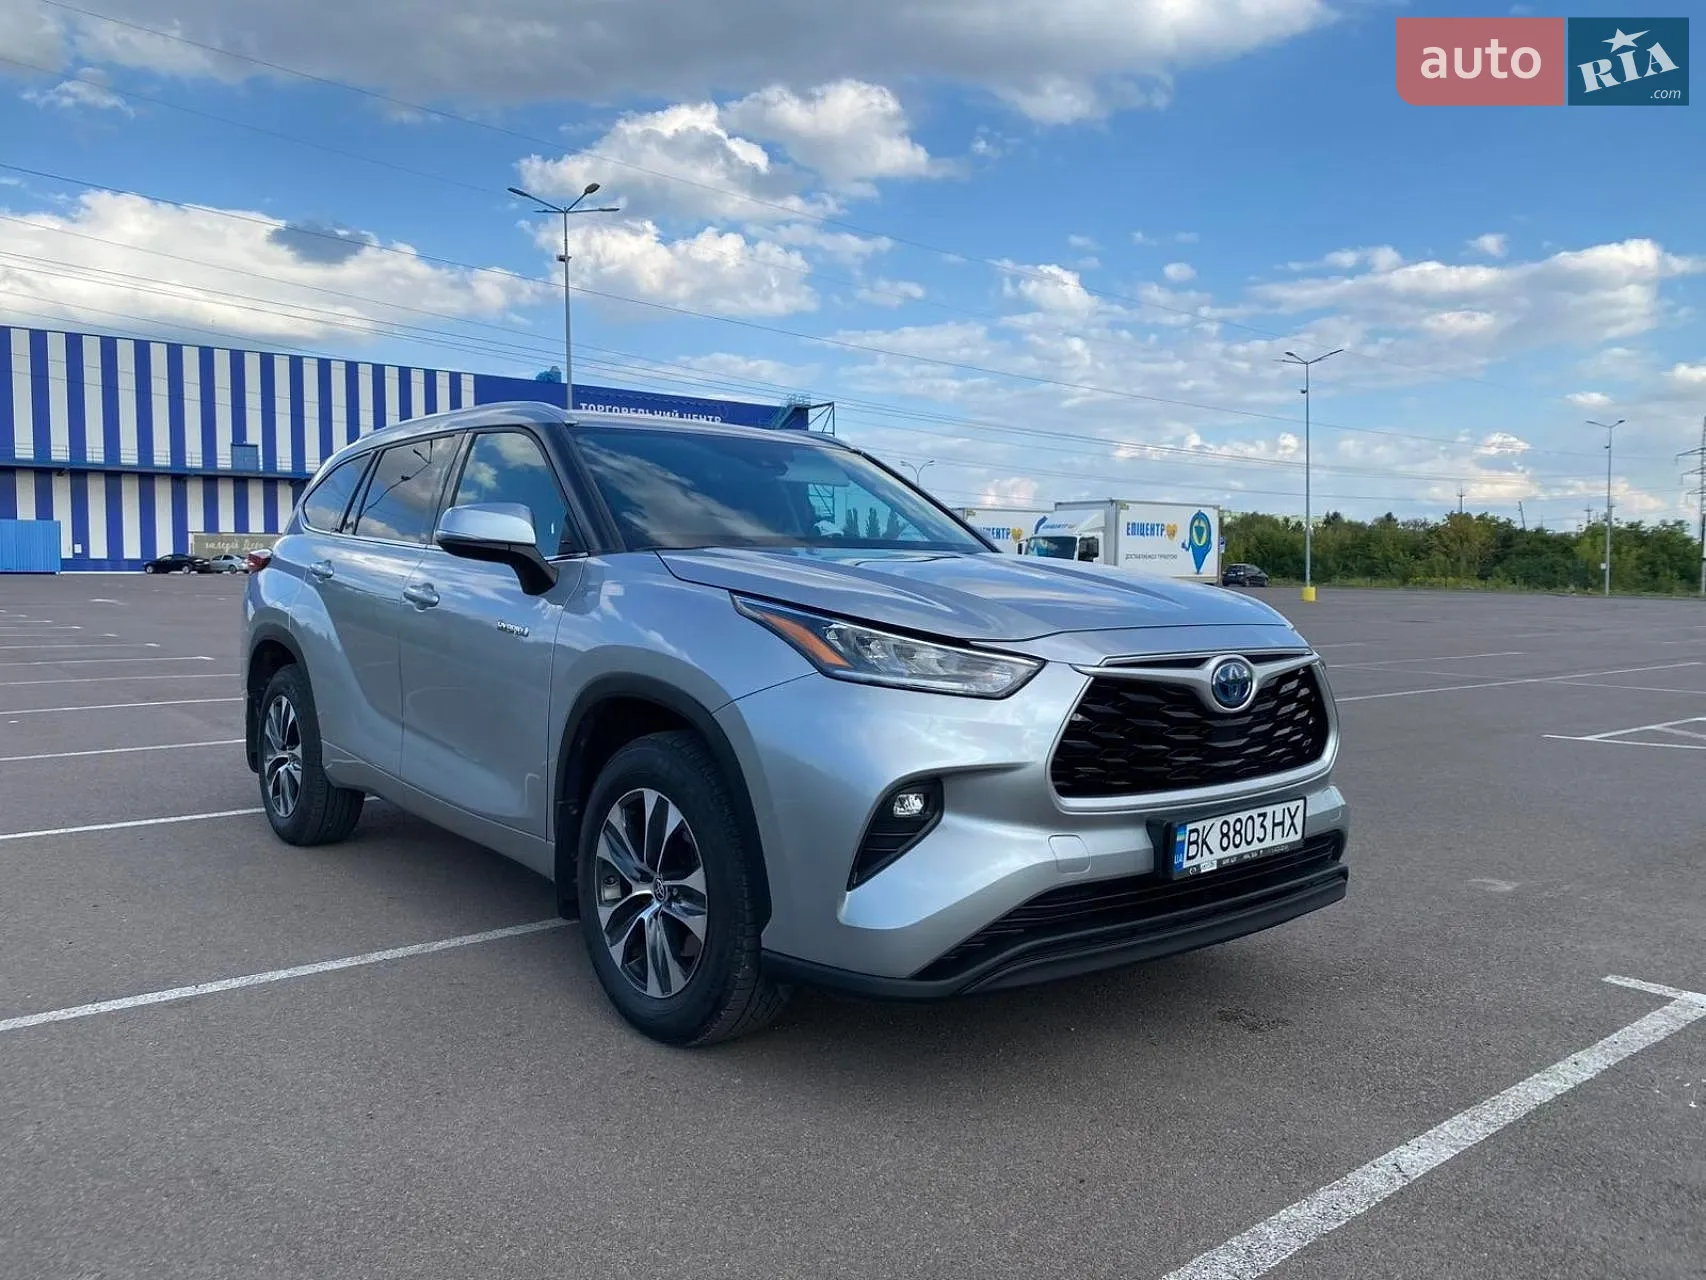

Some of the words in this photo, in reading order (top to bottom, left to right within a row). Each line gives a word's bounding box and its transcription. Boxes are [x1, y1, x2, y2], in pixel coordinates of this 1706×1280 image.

[1126, 521, 1165, 537] ЕПІЦЕНТР
[1186, 822, 1215, 861] BK
[1219, 811, 1268, 852] 8803
[1271, 805, 1300, 840] HX
